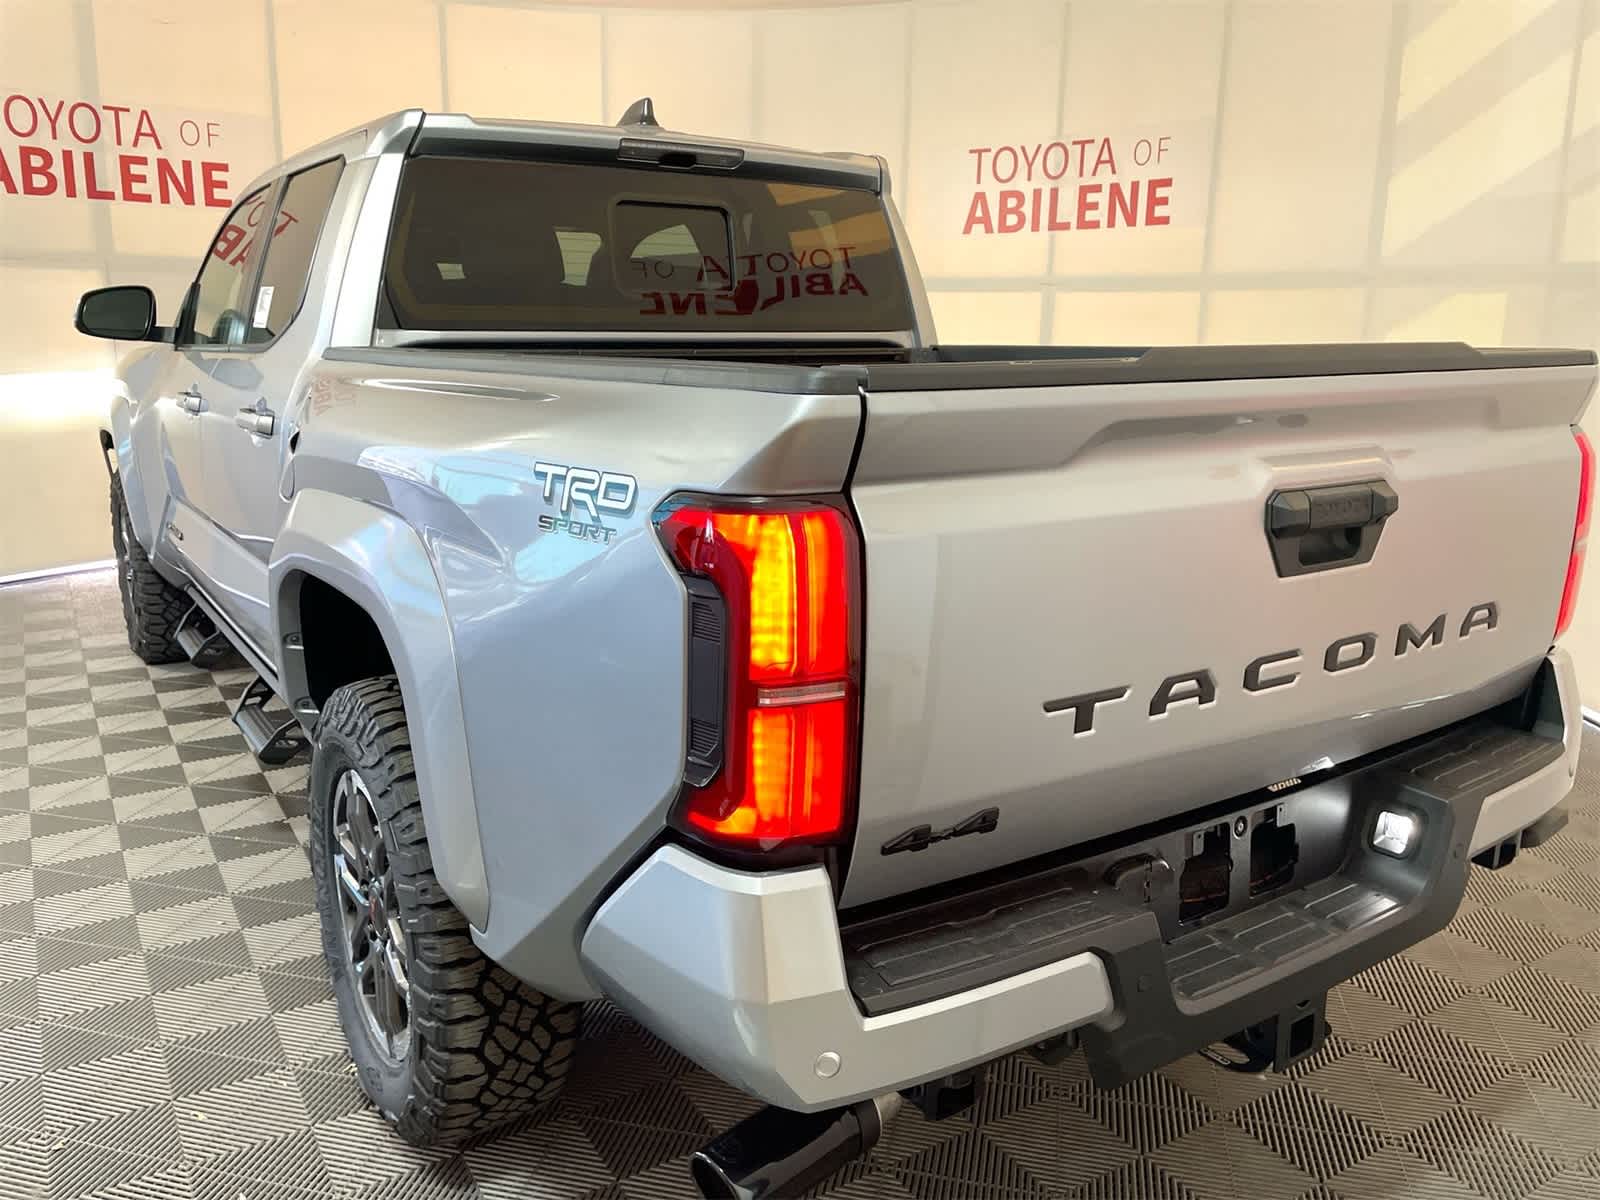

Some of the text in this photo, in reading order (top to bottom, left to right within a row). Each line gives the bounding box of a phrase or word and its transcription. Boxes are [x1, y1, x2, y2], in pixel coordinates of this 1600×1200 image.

[179, 119, 221, 148] OF
[968, 136, 1171, 184] TOYOTA OF
[962, 177, 1173, 235] ABILENE
[534, 461, 638, 522] TRD
[539, 514, 617, 543] SPORT
[1043, 601, 1499, 736] TACOMA
